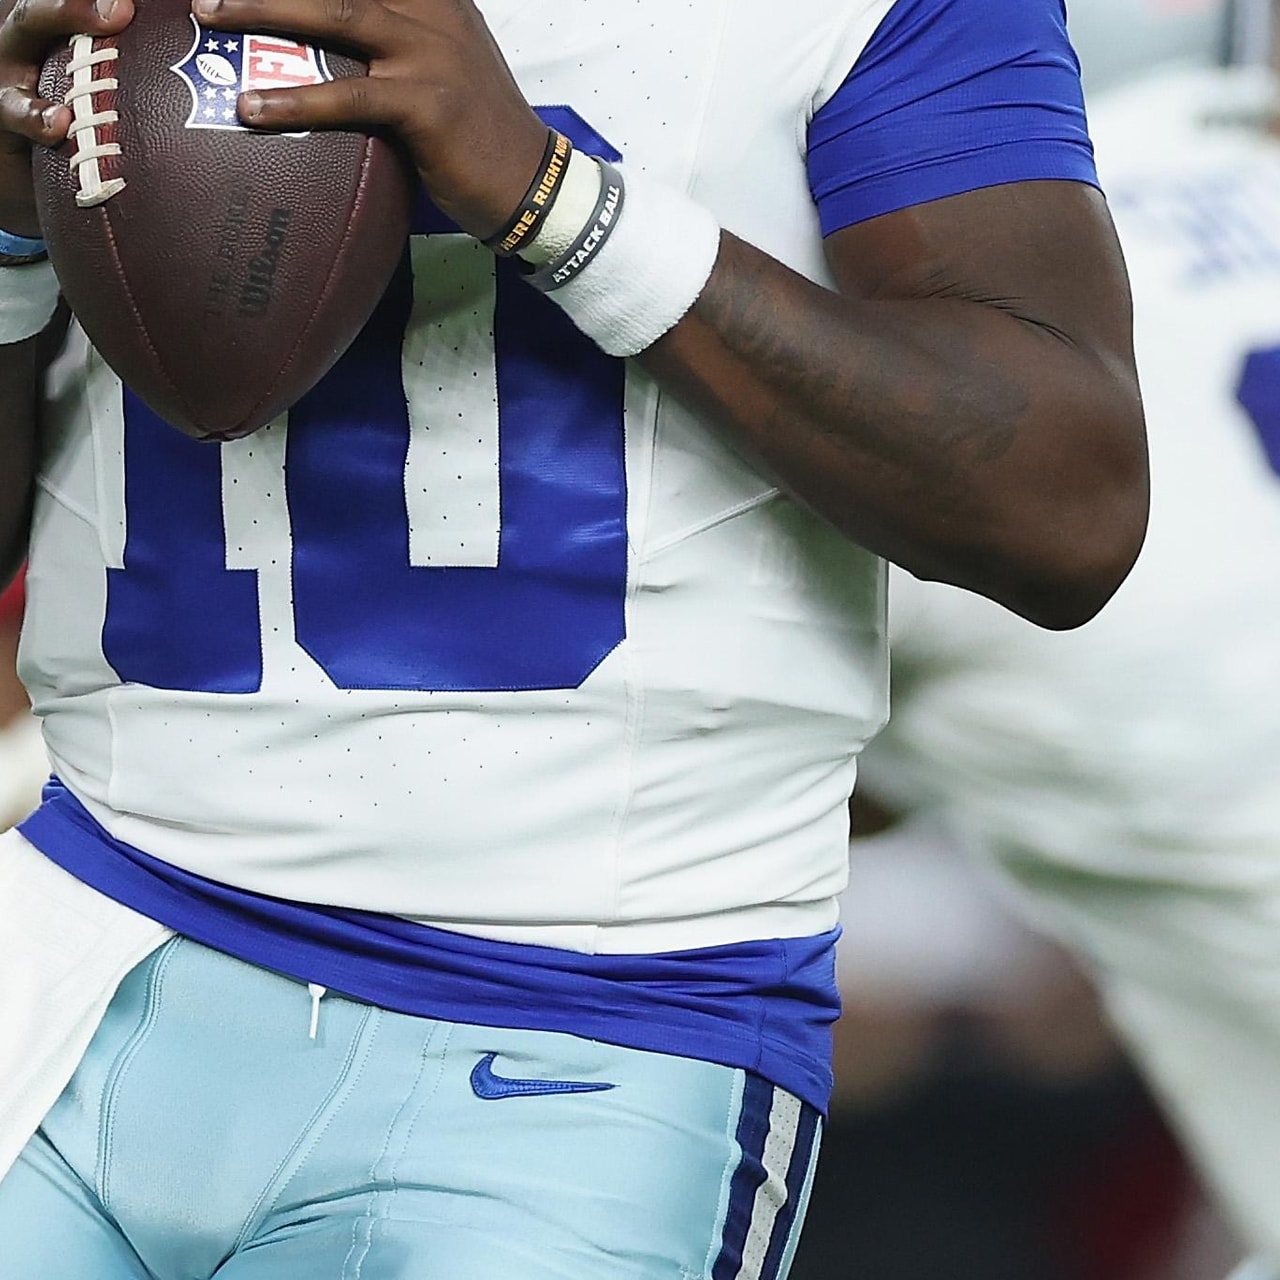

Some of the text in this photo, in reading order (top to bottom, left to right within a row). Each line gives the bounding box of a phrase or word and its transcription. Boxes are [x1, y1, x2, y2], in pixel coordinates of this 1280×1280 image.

[501, 209, 540, 251] HERE.
[532, 152, 564, 206] RIGHT
[552, 184, 620, 283] ATTACK BALL
[102, 106, 627, 694] 10
